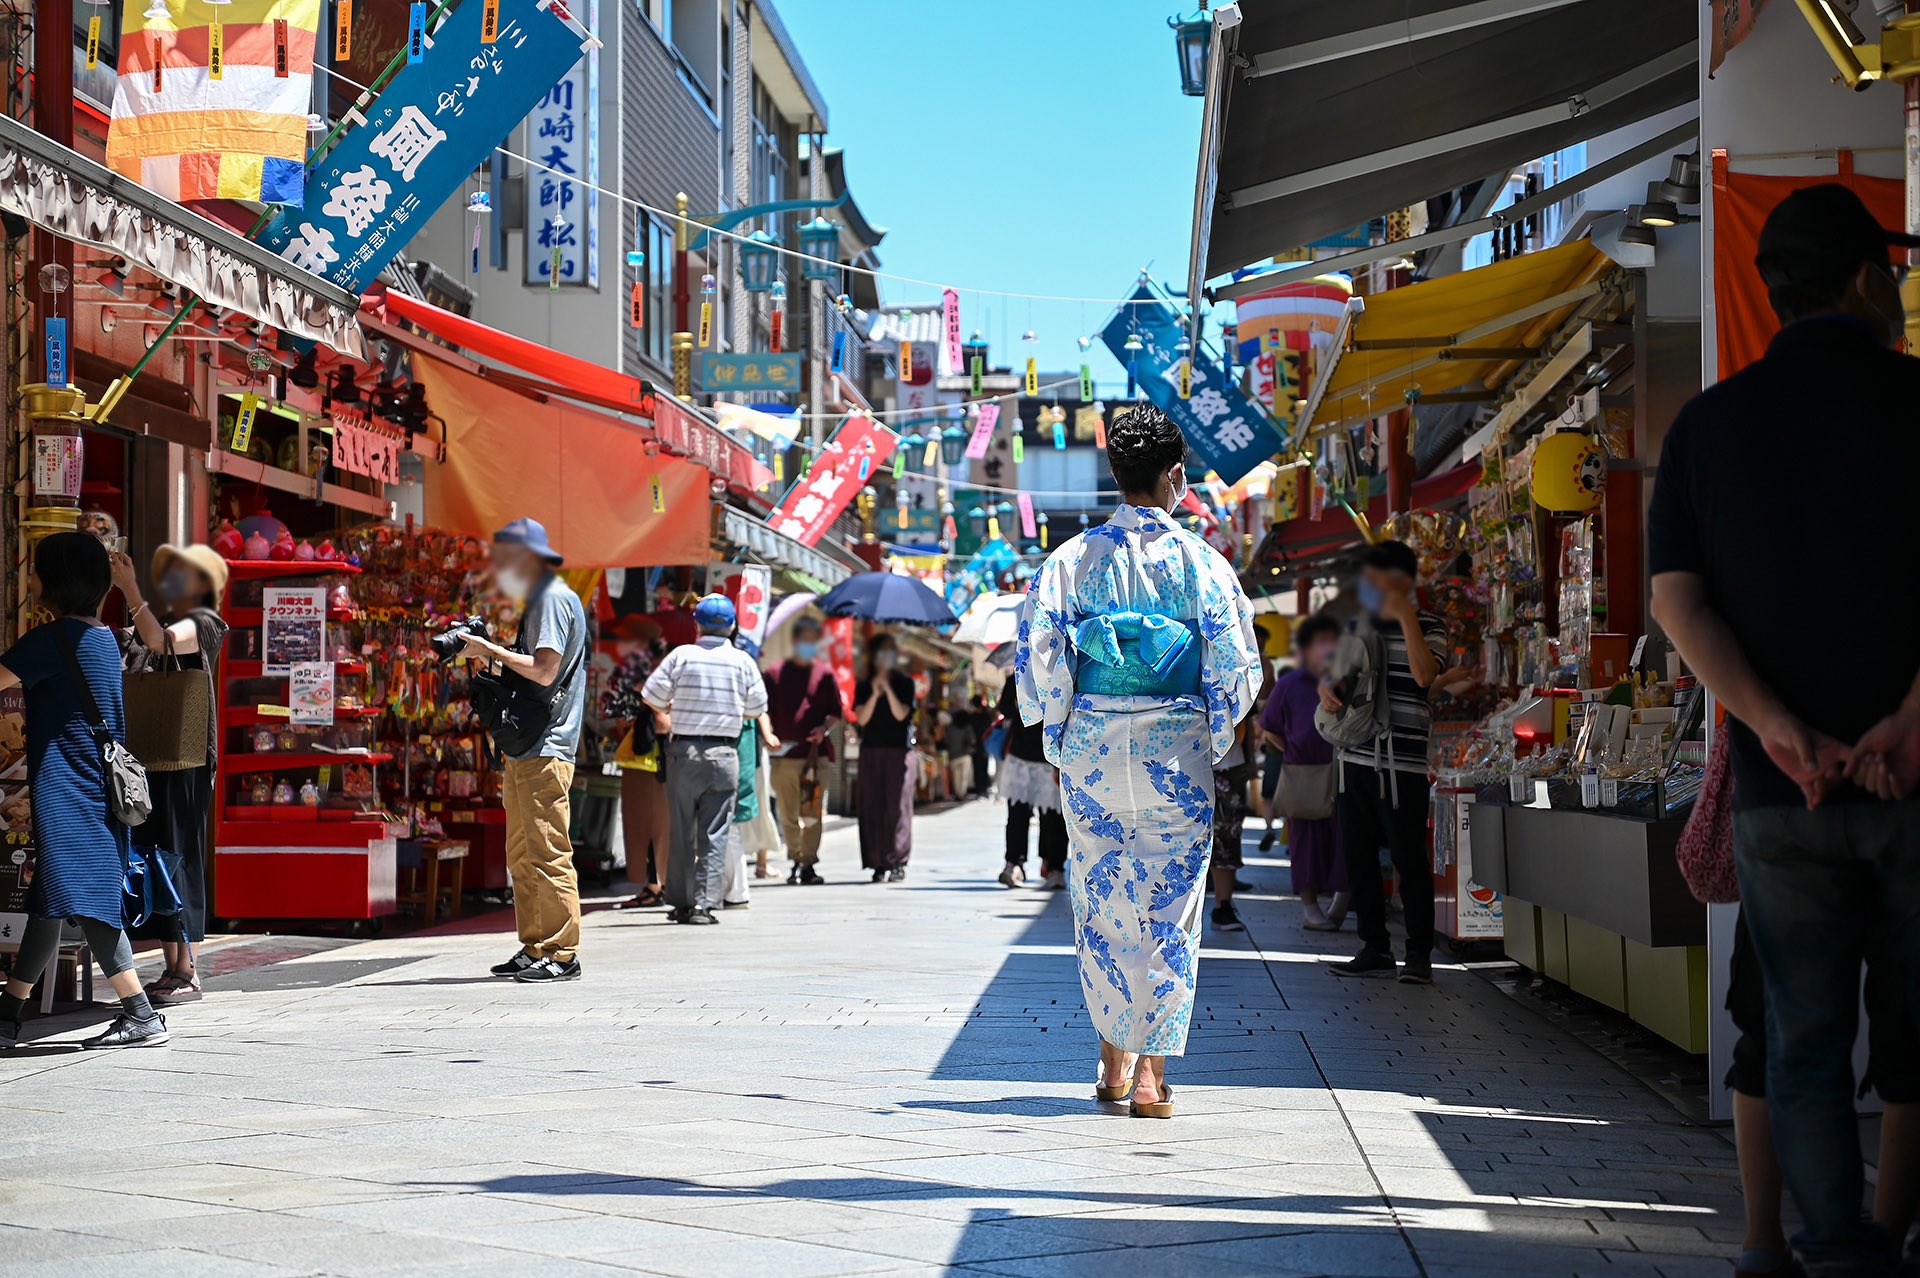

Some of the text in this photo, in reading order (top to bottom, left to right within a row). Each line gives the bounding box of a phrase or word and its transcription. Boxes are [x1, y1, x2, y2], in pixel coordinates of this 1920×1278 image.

[485, 8, 494, 36] 風鈴市
[88, 39, 96, 63] 風鈴市
[339, 27, 348, 54] 風鈴市
[412, 29, 420, 56] 風鈴市
[277, 45, 285, 72] 風鈴市
[537, 80, 576, 277] 川崎大師松山
[51, 341, 61, 370] 風鈴市
[240, 410, 251, 434] 風鈴市
[268, 607, 321, 615] タウンネット
[277, 597, 313, 606] 川崎大師
